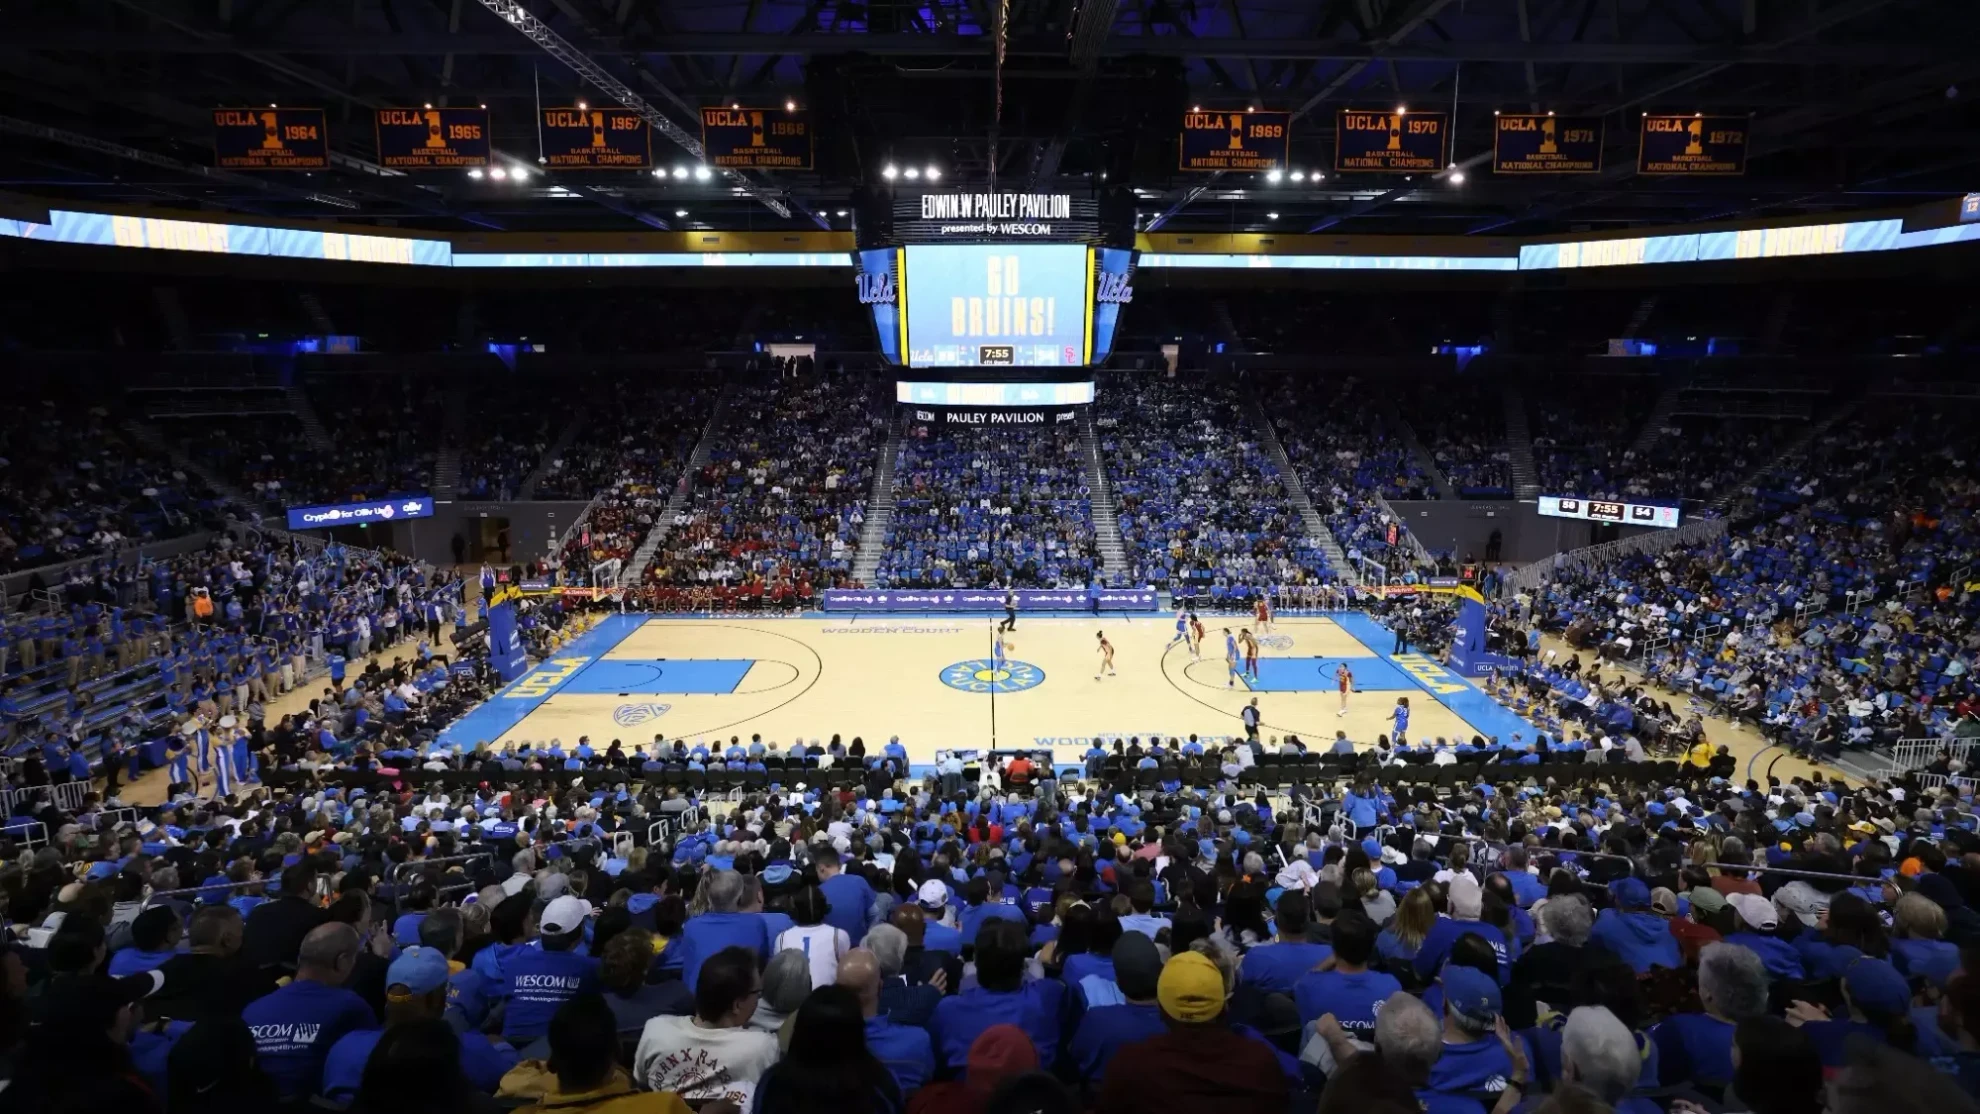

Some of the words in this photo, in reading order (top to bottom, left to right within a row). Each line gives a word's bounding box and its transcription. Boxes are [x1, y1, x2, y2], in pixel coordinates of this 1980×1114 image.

[215, 112, 257, 126] UCLA
[380, 111, 422, 124] UCLA
[546, 112, 589, 127] UCLA
[612, 117, 641, 130] 1967
[706, 112, 748, 126] UCLA
[1185, 114, 1224, 129] UCLA
[1346, 116, 1386, 130] UCLA
[1408, 120, 1438, 134] 1970
[1500, 119, 1536, 130] UCLA
[1647, 120, 1682, 132] UCLA
[285, 126, 318, 140] 1964
[449, 125, 480, 139] 1965
[1249, 125, 1282, 138] 1969
[1564, 130, 1594, 142] 1971
[222, 157, 266, 166] NATIONAL
[385, 156, 431, 164] NATIONAL
[550, 155, 590, 164] NATIONAL
[715, 156, 753, 164] NATIONAL
[1191, 158, 1228, 166] NATIONAL
[1344, 158, 1384, 167] NATIONAL
[922, 194, 958, 218] EDWIN
[961, 194, 973, 218] W
[976, 194, 1018, 218] PAULEY
[1020, 194, 1070, 218] PAVILION
[942, 224, 984, 234] presented
[986, 224, 998, 234] by
[1000, 224, 1050, 235] WESCOM
[987, 255, 1020, 296] GO
[952, 296, 1056, 336] BRUINS!
[984, 349, 1009, 358] 7:55
[947, 412, 986, 424] PAULEY
[991, 412, 1044, 423] PAVILION
[1594, 504, 1618, 514] 7:55
[1636, 508, 1650, 516] 54
[502, 656, 592, 698] UCLA
[1390, 653, 1470, 694] UCLA
[516, 974, 566, 988] WESCOM
[248, 1024, 294, 1038] SCOM
[1338, 1020, 1375, 1029] SCOM
[680, 1048, 692, 1062] X
[725, 1090, 748, 1104] USC
